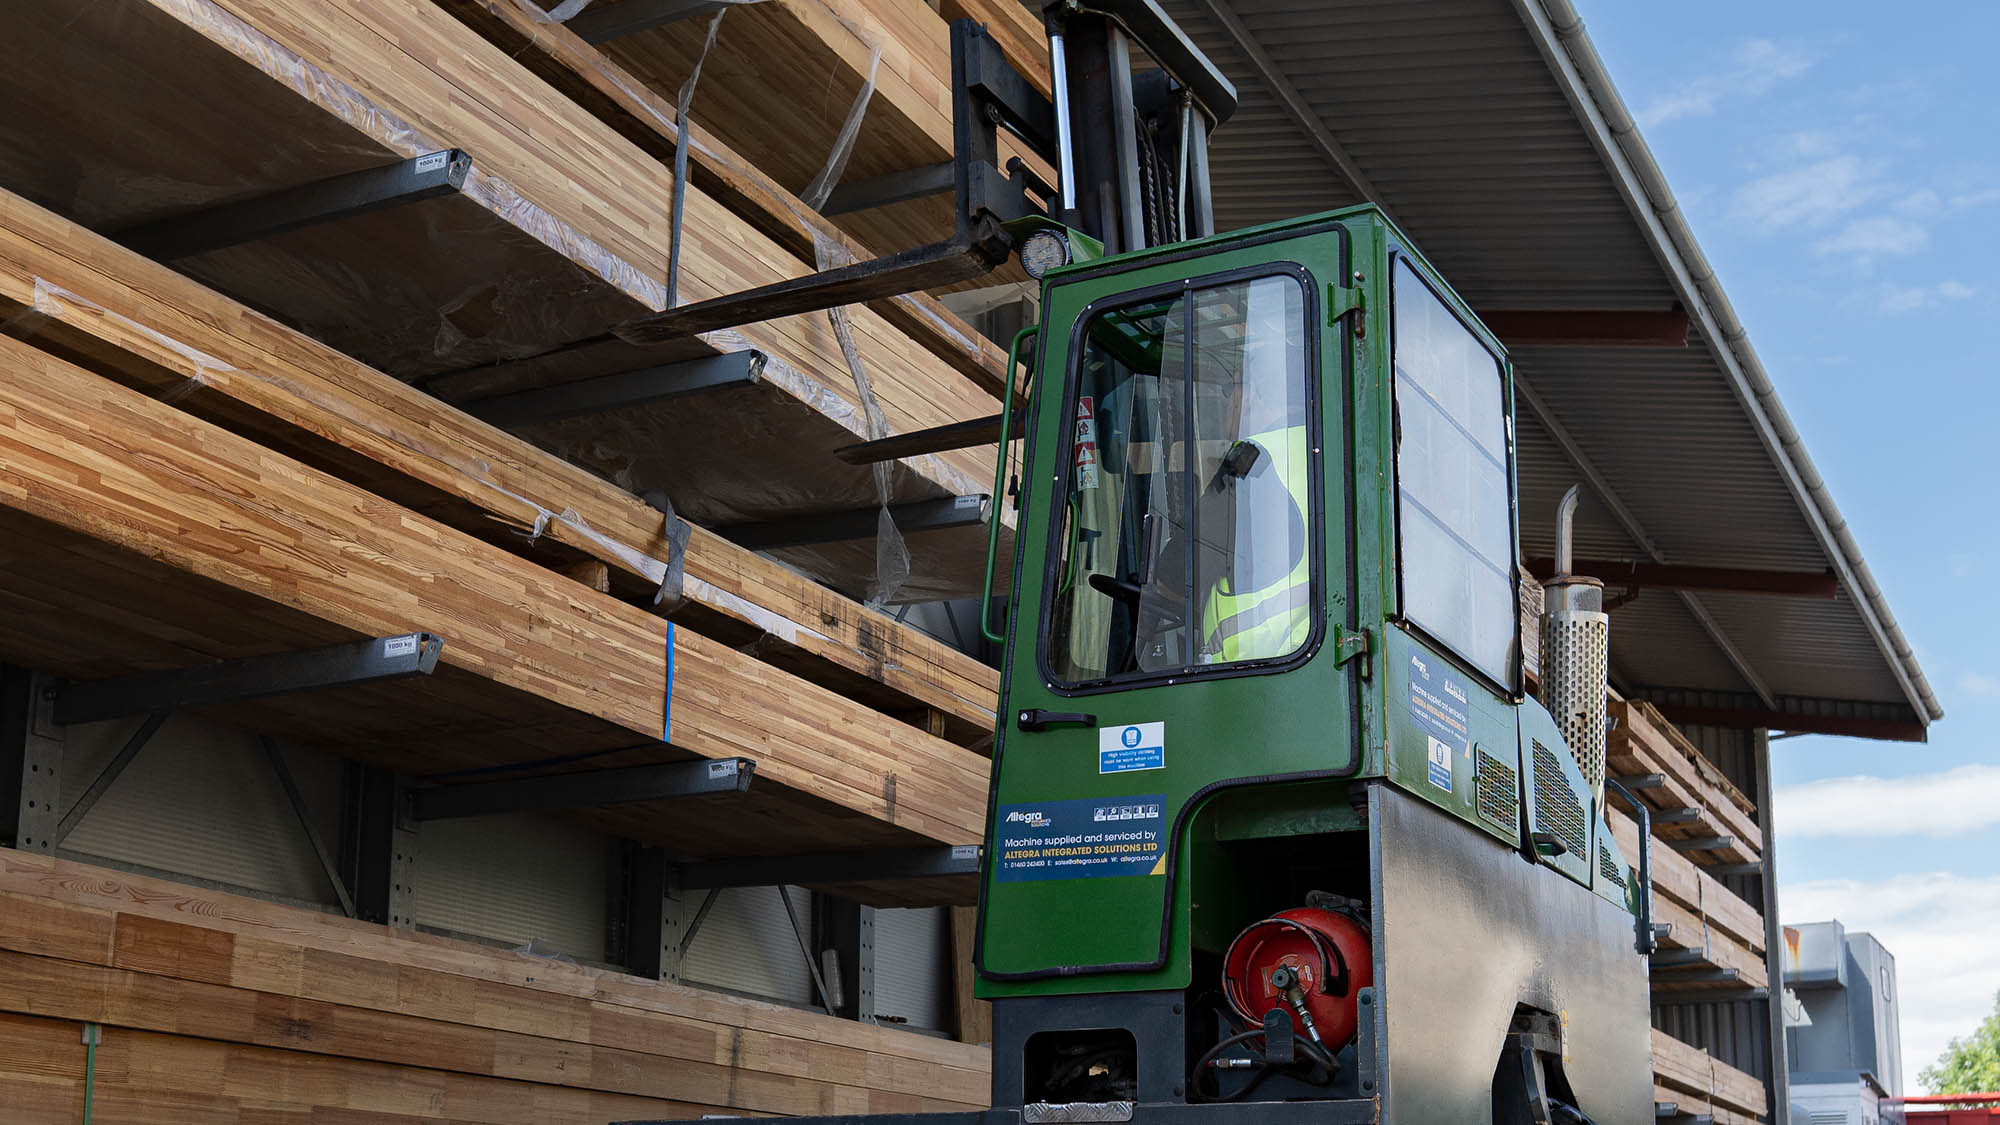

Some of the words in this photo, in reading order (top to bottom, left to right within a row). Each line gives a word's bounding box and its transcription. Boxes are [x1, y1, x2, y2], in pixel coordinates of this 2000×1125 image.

[1004, 837, 1043, 848] Machine
[1044, 834, 1082, 846] supplied
[1084, 833, 1102, 843] and
[1104, 831, 1143, 841] serviced
[1144, 830, 1156, 840] by
[1004, 850, 1040, 859] ALTEGRA
[1042, 846, 1092, 857] INTEGRATED
[1094, 844, 1141, 854] SOLUTIONS
[1143, 842, 1158, 852] LTD
